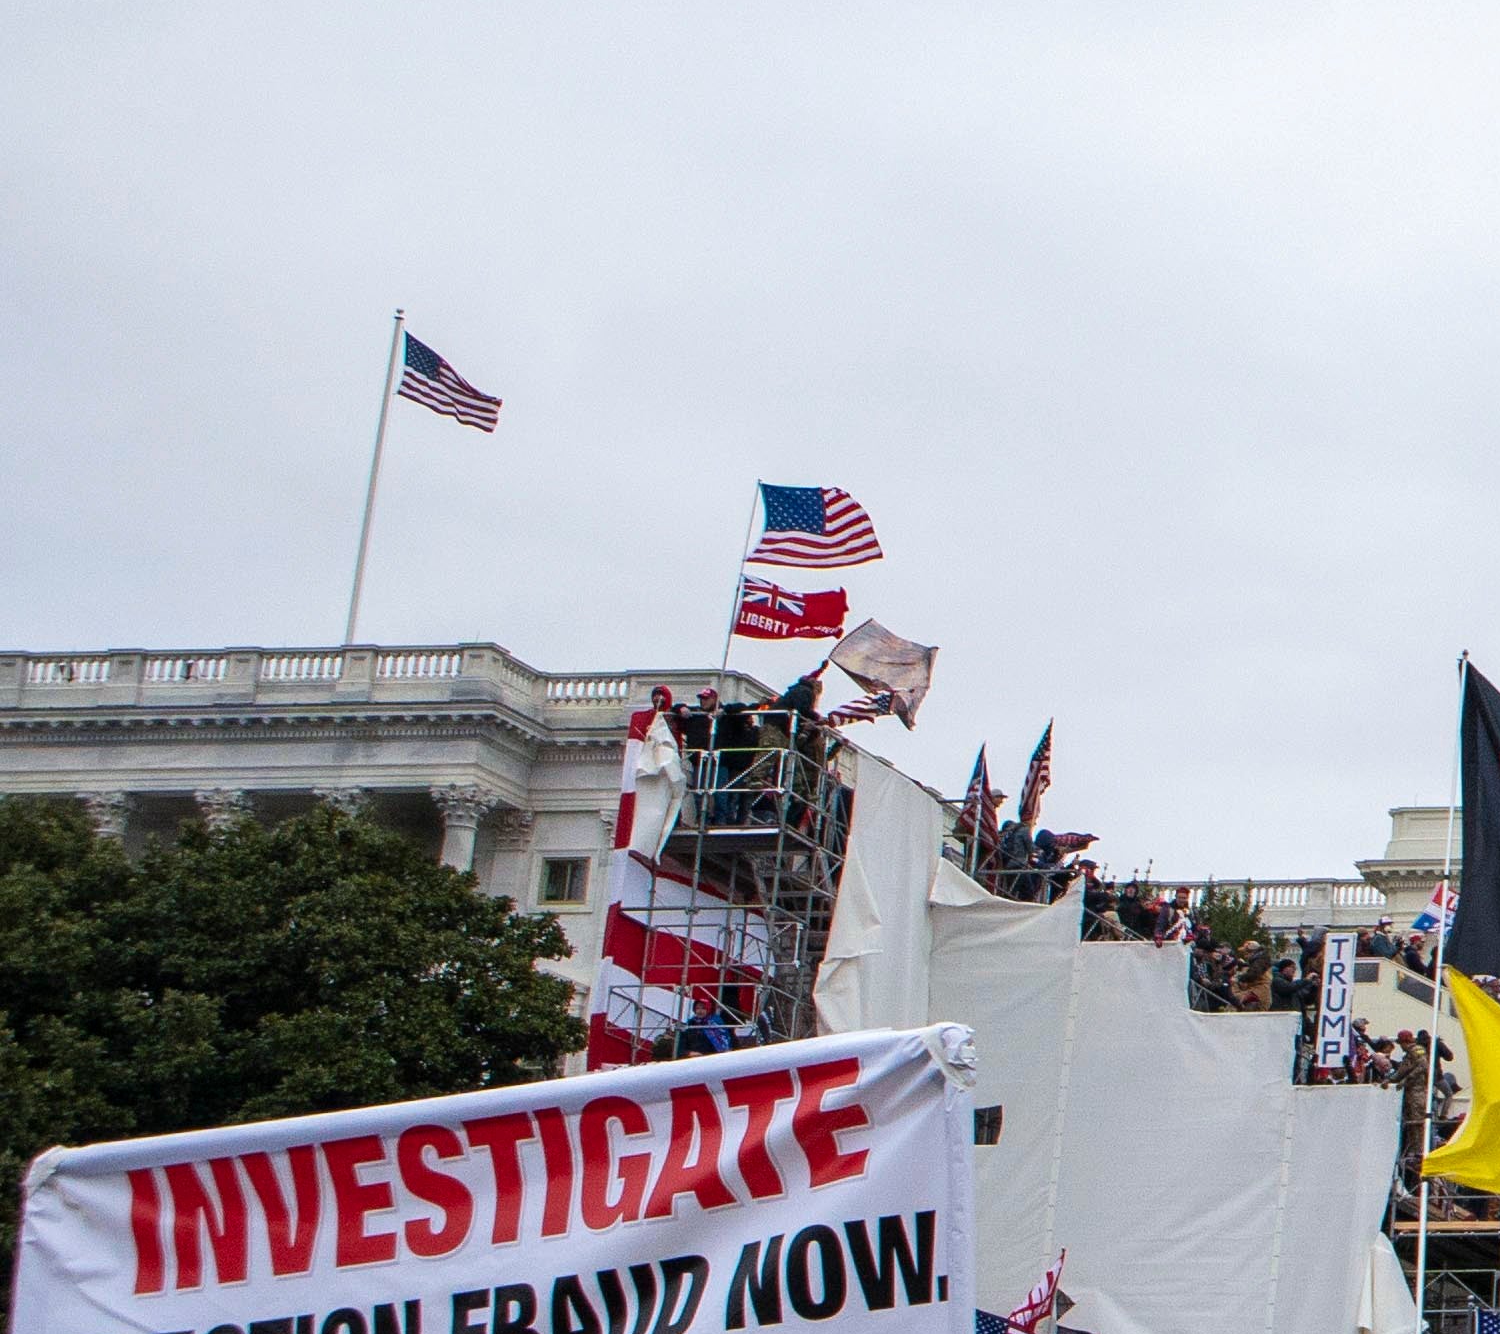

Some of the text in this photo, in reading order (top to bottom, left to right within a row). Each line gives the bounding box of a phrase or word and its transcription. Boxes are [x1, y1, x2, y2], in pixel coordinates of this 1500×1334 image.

[740, 611, 790, 636] LIBERTY
[1320, 938, 1348, 1066] TRUMP
[127, 1056, 871, 1296] INVESTIGATE
[725, 1209, 949, 1332] NOW.
